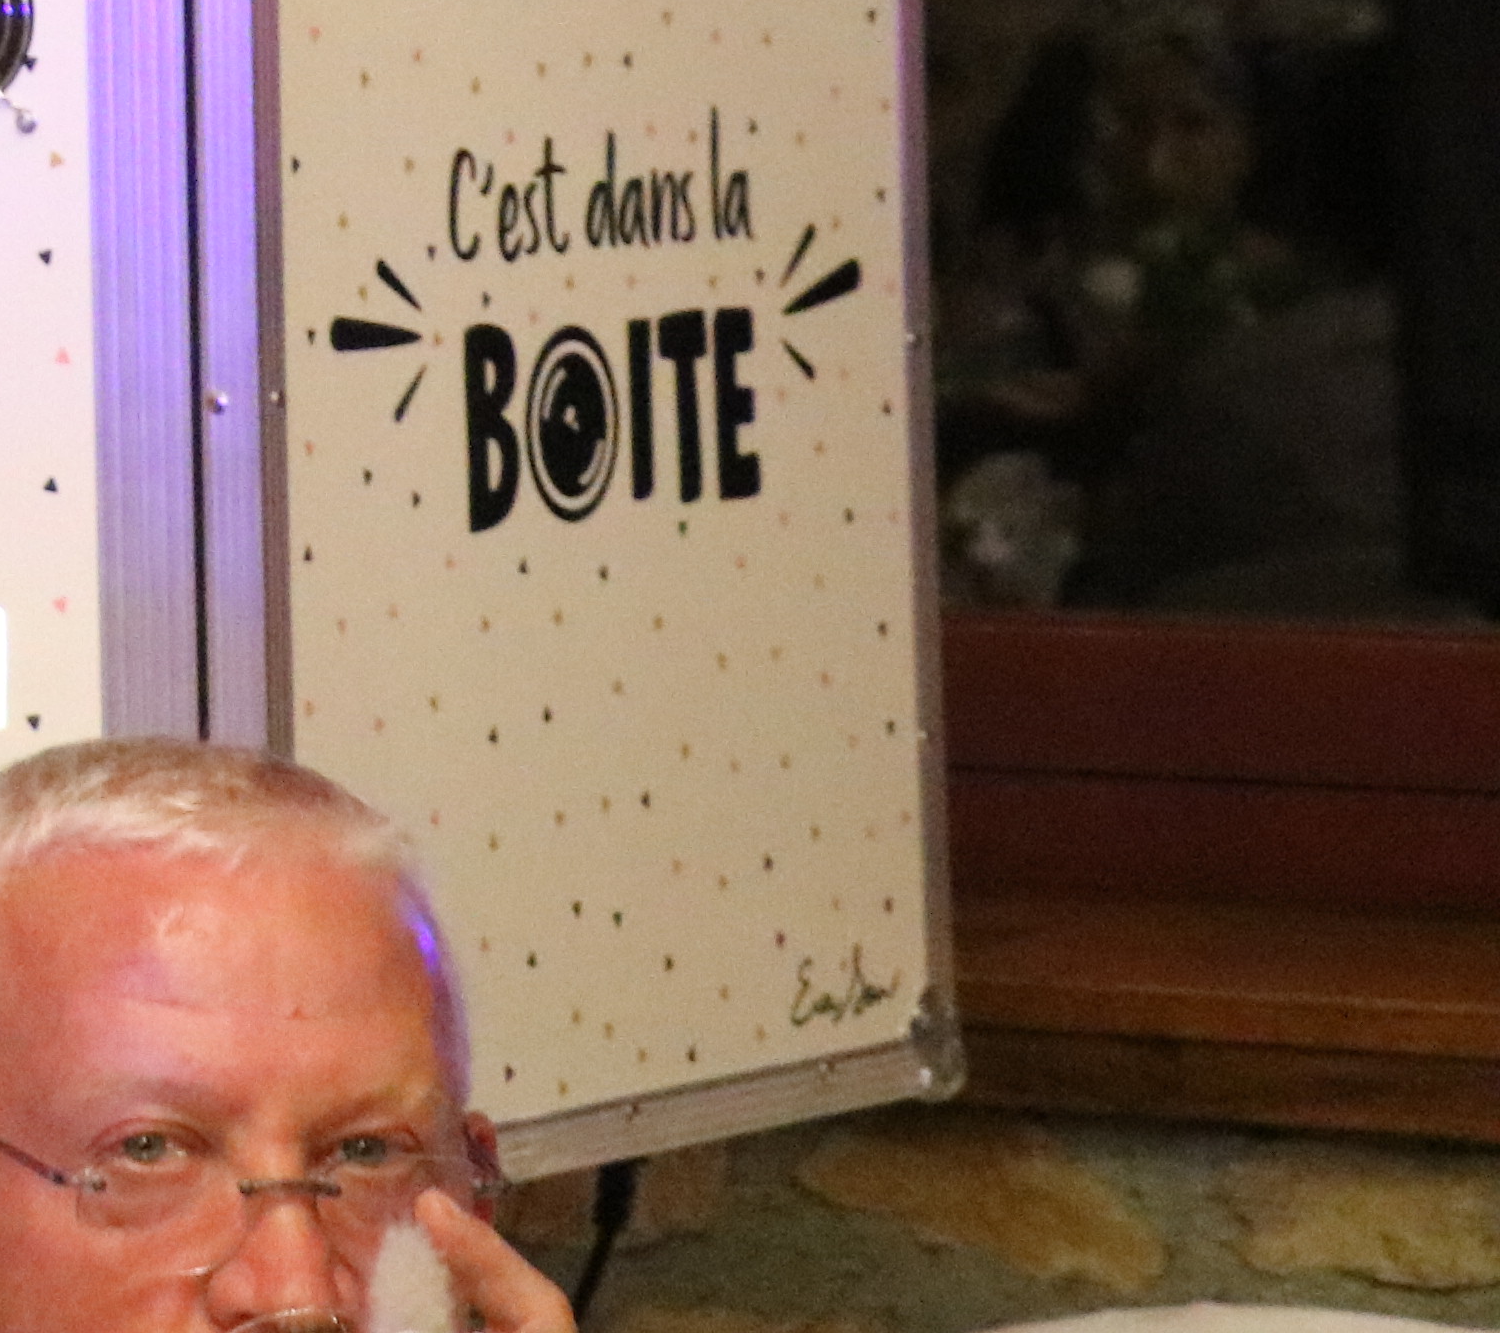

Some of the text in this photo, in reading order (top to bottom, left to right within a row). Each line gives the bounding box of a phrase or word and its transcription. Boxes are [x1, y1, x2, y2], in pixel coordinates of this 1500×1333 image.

[448, 105, 755, 262] C'est dans la
[462, 306, 762, 534] BOITE
